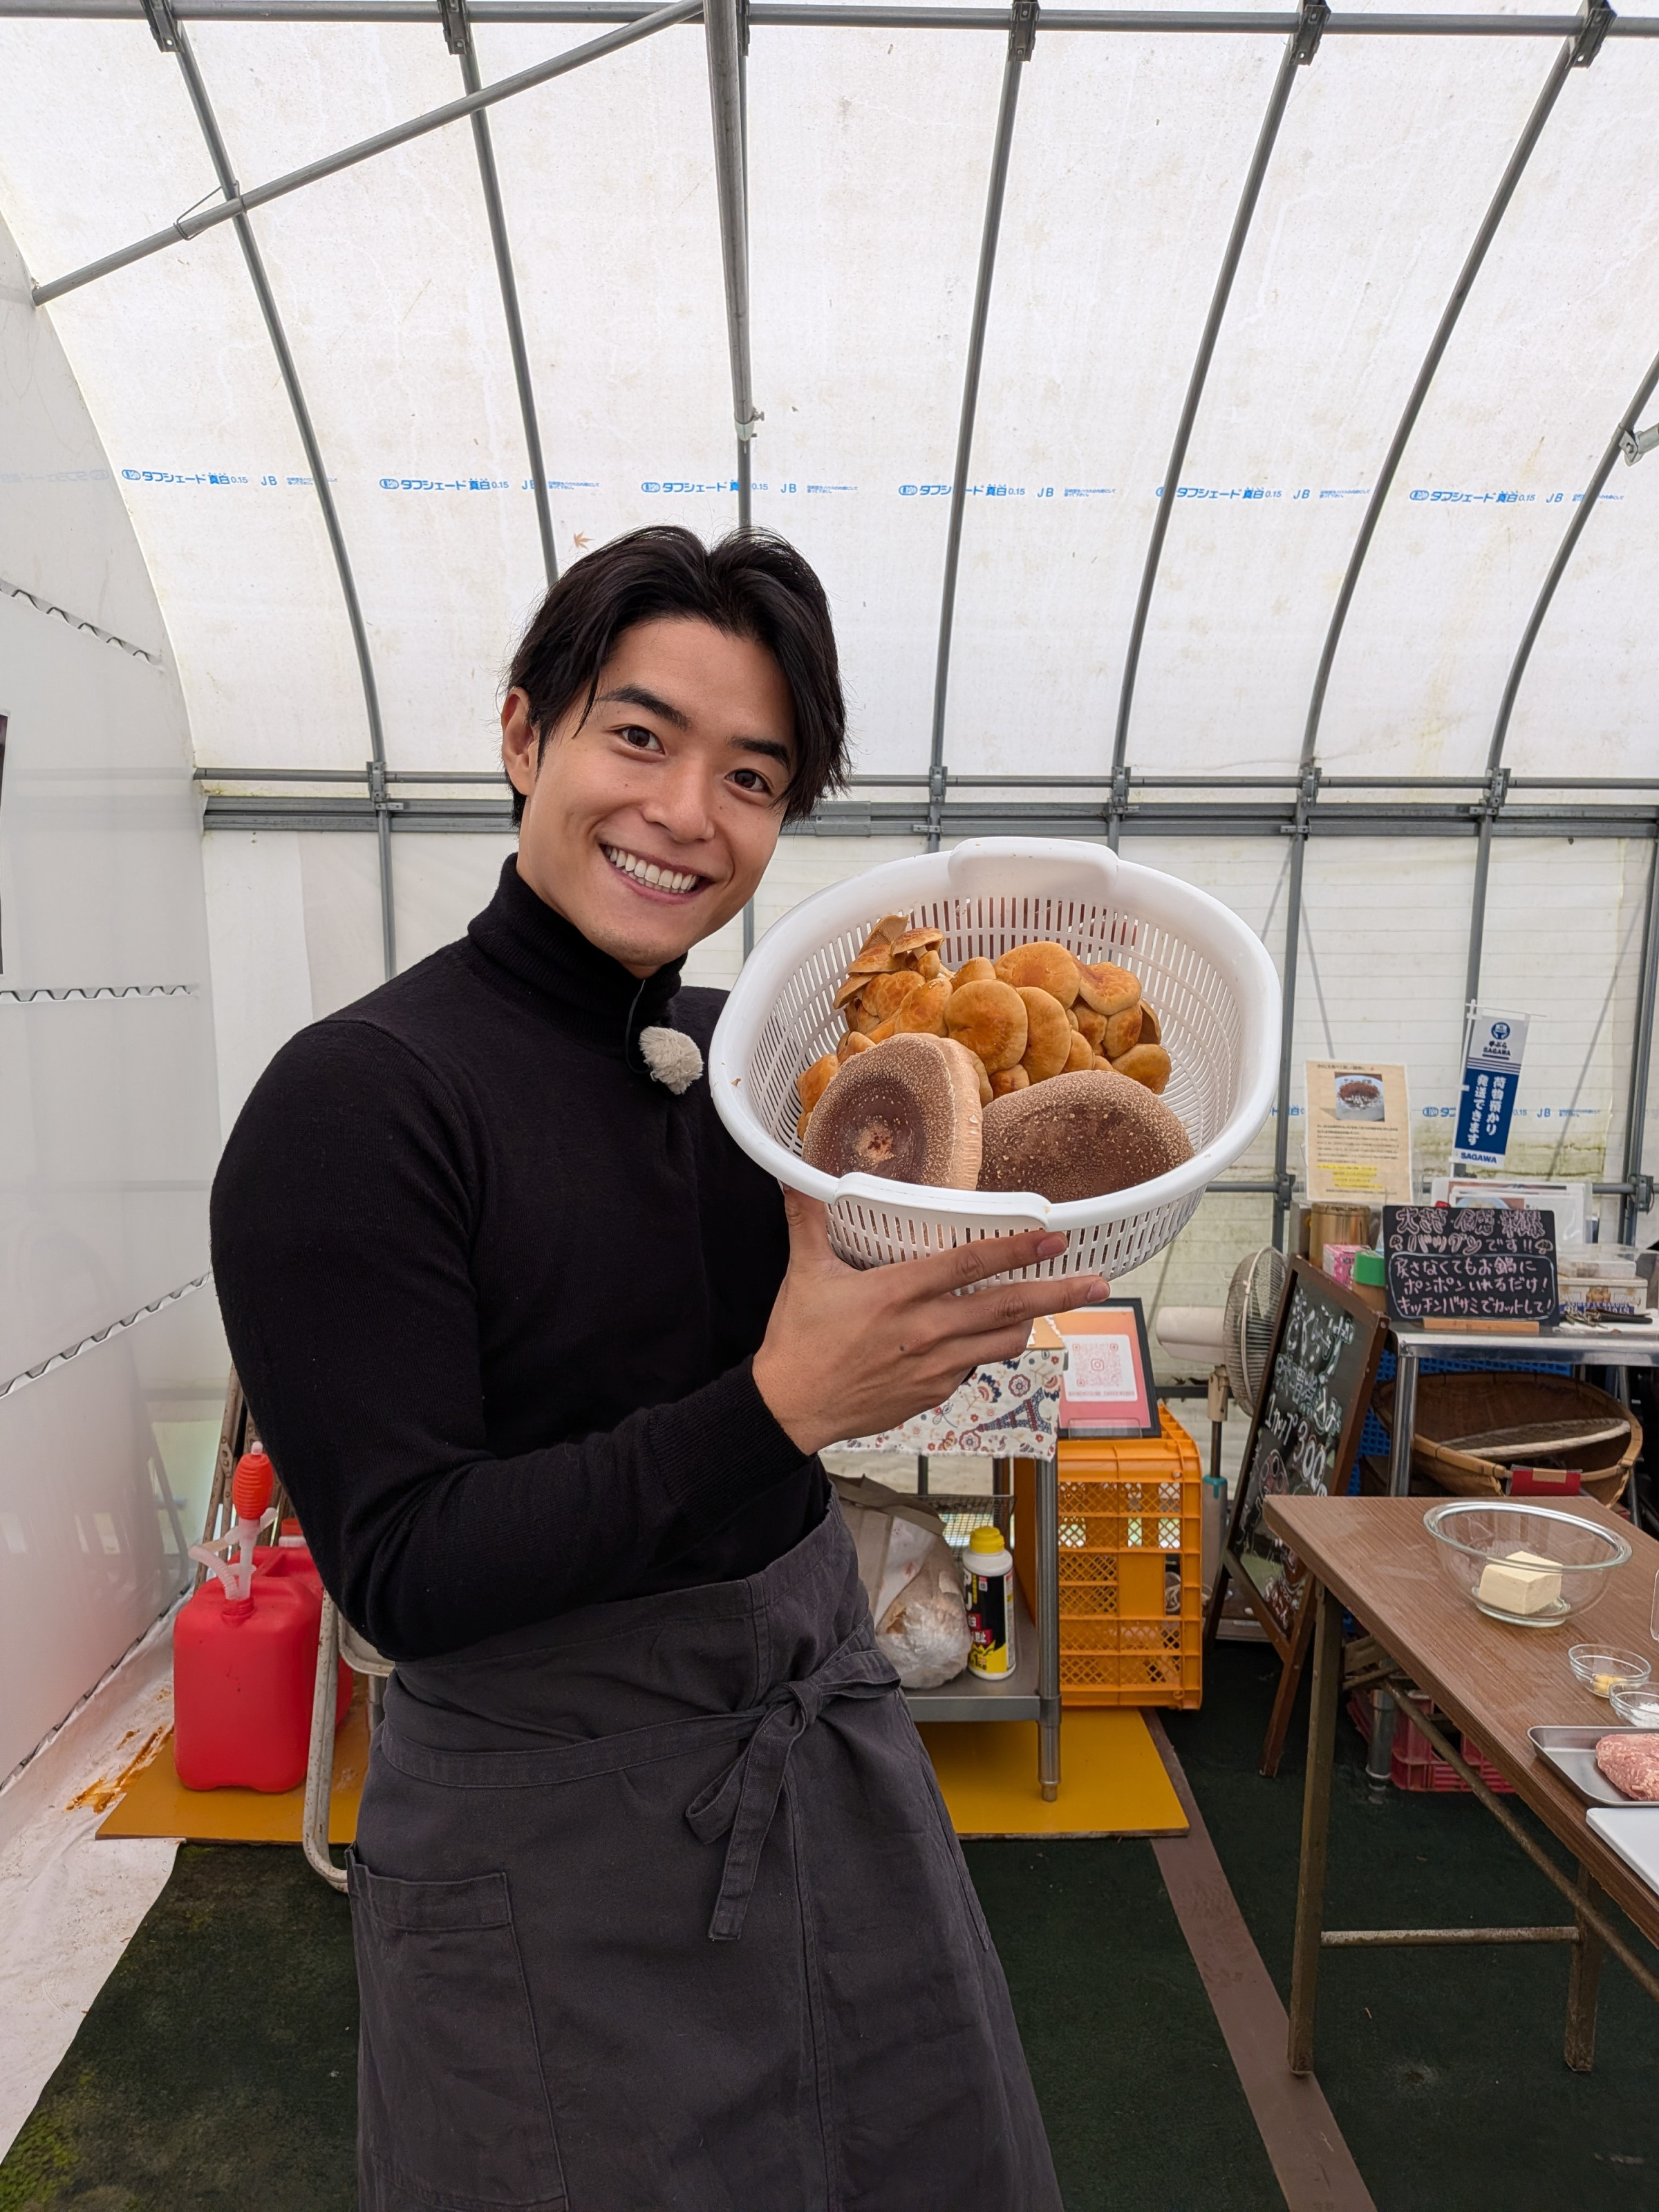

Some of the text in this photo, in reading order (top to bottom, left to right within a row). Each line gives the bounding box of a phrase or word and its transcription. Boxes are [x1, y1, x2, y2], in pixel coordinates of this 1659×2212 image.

[261, 476, 277, 486] JB
[780, 483, 796, 493] JB
[919, 485, 984, 496] タフシード
[1037, 487, 1054, 498] JB
[1293, 489, 1311, 499] JB
[1546, 493, 1564, 503] JB
[1483, 1047, 1511, 1056] SAGAWA
[1468, 1074, 1489, 1145] 発送できます
[1486, 1076, 1507, 1136] 荷物預かり
[1537, 1108, 1551, 1118] JB
[1461, 1152, 1497, 1163] SAGAWA
[1395, 1257, 1537, 1278] 戻さなくてもお鍋に
[1404, 1277, 1548, 1295] ポンポンいれるだけ!
[1397, 1296, 1552, 1314] キッチンバサミでカットして!
